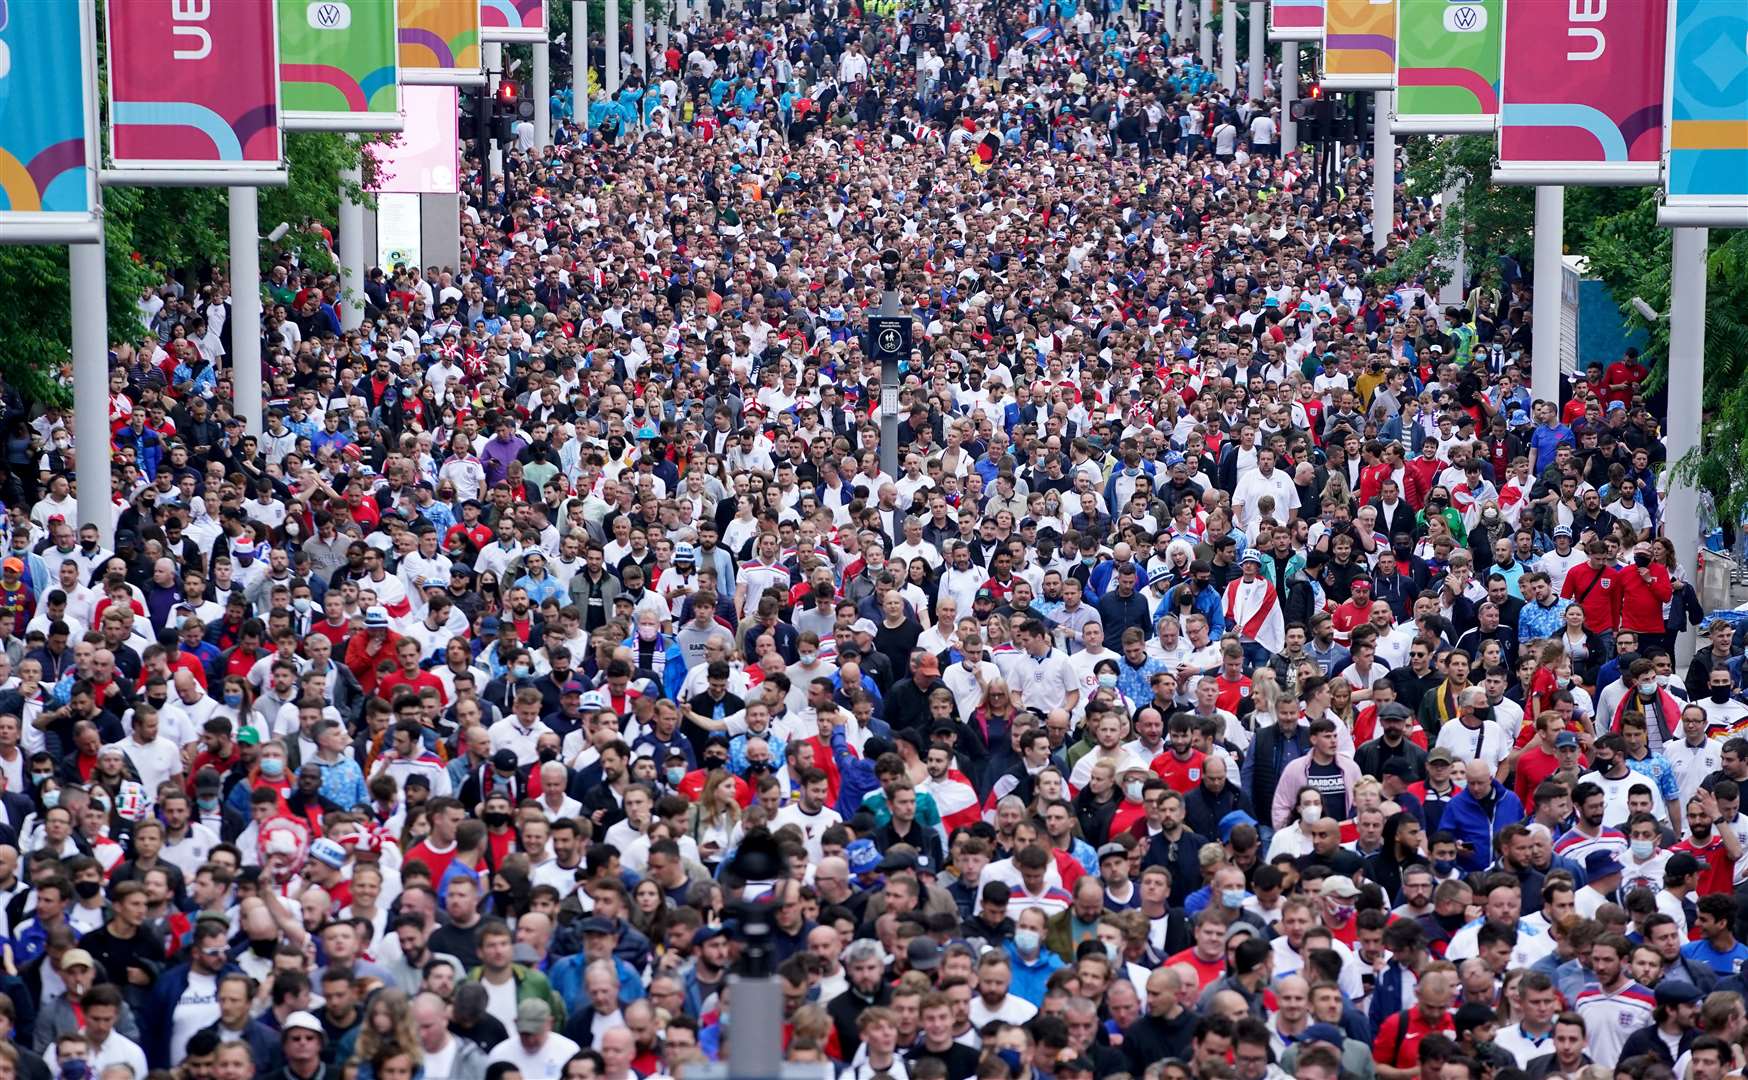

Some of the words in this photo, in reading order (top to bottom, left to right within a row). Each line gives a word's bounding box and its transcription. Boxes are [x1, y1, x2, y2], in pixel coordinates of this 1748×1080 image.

[172, 0, 212, 60] UE
[1567, 0, 1606, 60] UE
[1345, 616, 1352, 627] 7
